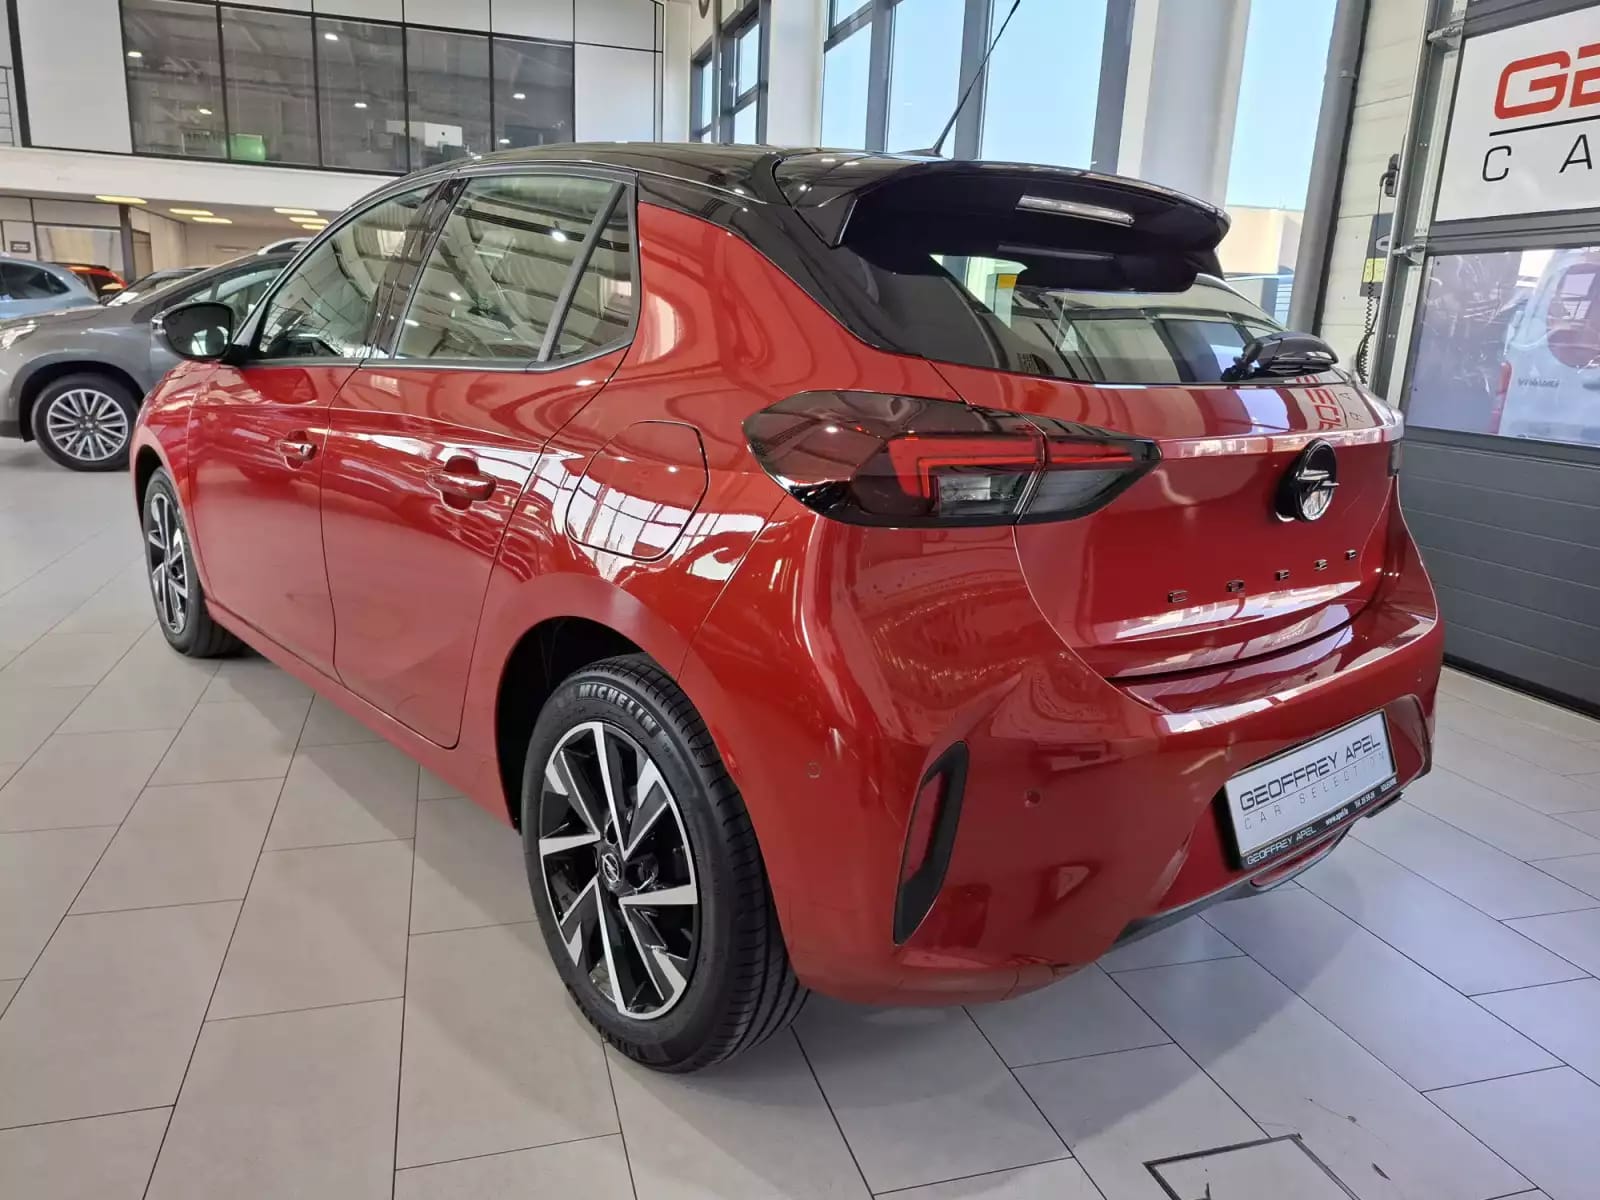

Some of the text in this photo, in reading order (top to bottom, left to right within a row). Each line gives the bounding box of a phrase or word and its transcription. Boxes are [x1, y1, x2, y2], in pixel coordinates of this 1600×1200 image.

[578, 684, 657, 731] MICHELIN
[1239, 750, 1338, 811] GEOFFREY
[1345, 734, 1381, 764] APEL
[1244, 804, 1282, 831] CAR
[1299, 751, 1385, 805] SELECTON
[1247, 835, 1294, 865] GEOFFREY
[1296, 825, 1318, 842] APEL
